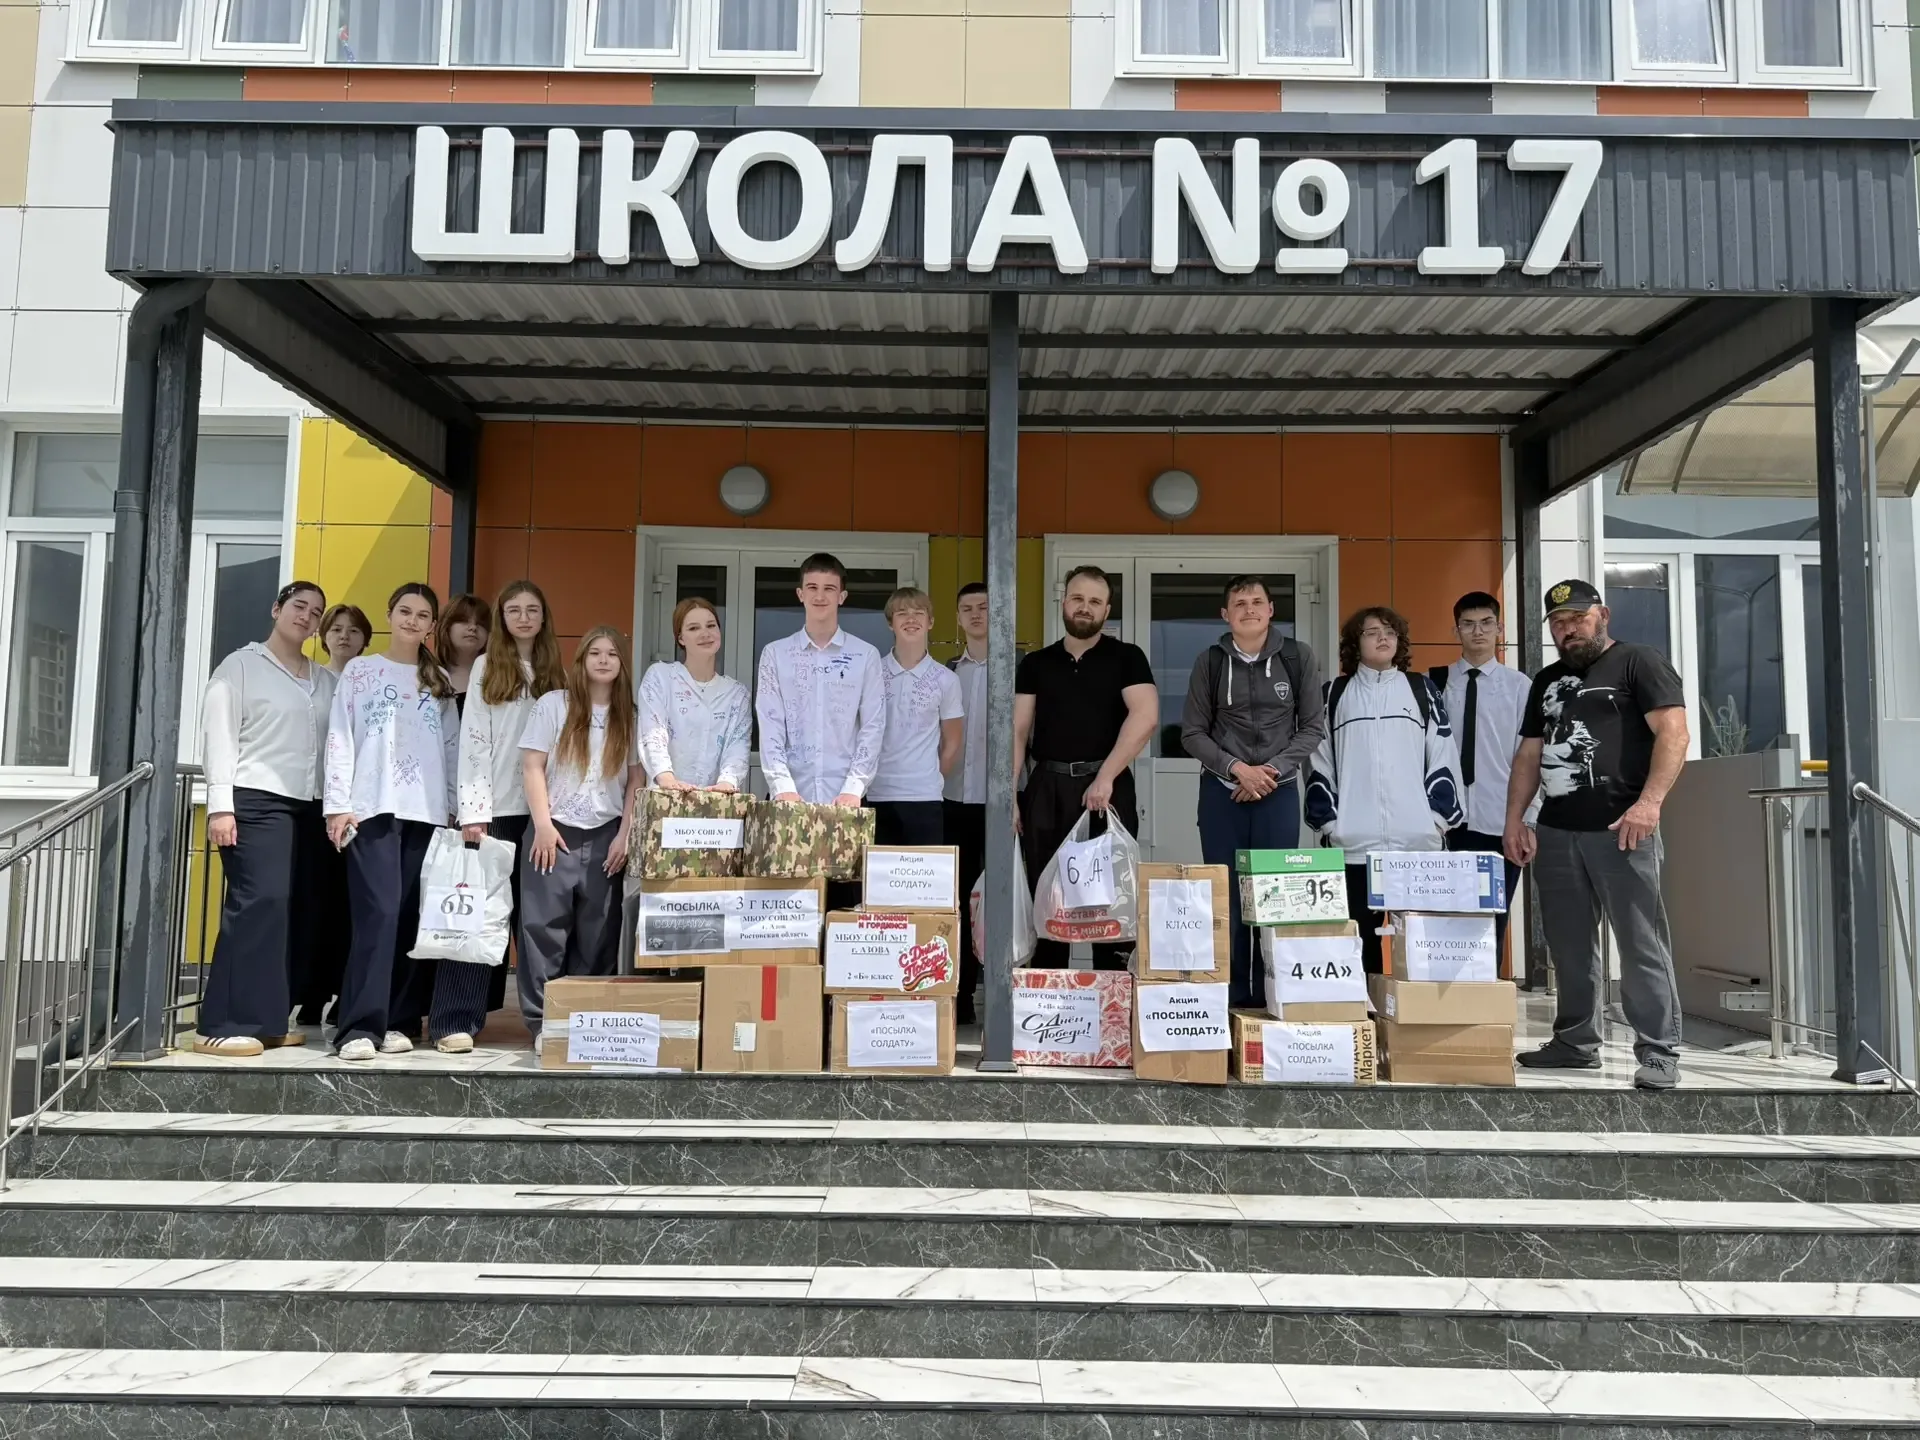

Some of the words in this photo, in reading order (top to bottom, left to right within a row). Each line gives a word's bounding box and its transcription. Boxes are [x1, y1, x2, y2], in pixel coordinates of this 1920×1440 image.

[411, 126, 1090, 275] ШКОЛА
[1151, 137, 1350, 275] №
[1416, 138, 1604, 277] 17
[674, 828, 697, 836] МБОУ
[697, 828, 716, 836] СОШ
[899, 855, 924, 863] Акция
[1389, 860, 1418, 869] МБОУ
[1420, 860, 1445, 869] СОШ
[1447, 860, 1458, 869] №
[1461, 860, 1470, 869] 17
[890, 867, 935, 876] «ПОСЫЛКА
[1067, 856, 1080, 885] 6
[889, 880, 932, 889] СОЛДАТУ»
[440, 893, 474, 916] 6Б
[660, 901, 720, 912] «ПОСЫЛКА
[736, 895, 744, 910] 3
[749, 900, 757, 910] г
[761, 899, 803, 910] класс
[1054, 908, 1108, 920] Доставка
[1177, 906, 1190, 916] 8Г
[742, 914, 768, 922] МБОУ
[768, 913, 789, 921] СОШ
[1165, 920, 1202, 930] КЛАСС
[1051, 925, 1064, 935] от
[1067, 926, 1078, 936] 15
[1080, 924, 1115, 936] минут
[740, 932, 780, 940] Ростовская
[781, 931, 809, 939] область
[834, 933, 864, 941] МБОУ
[864, 933, 887, 941] СОШ
[1415, 940, 1441, 949] МБОУ
[1444, 940, 1467, 949] СОШ
[1468, 941, 1487, 949] №17
[860, 946, 890, 954] АЗОВА
[1291, 962, 1304, 980] 4
[1310, 961, 1352, 979] «А»
[847, 972, 852, 980] 2
[1168, 996, 1199, 1005] Акция
[880, 1012, 905, 1021] Акция
[1145, 1010, 1209, 1021] «ПОСЫЛКА
[576, 1013, 584, 1028] 3
[589, 1017, 597, 1027] г
[602, 1016, 644, 1027] класс
[1021, 1013, 1044, 1031] С
[870, 1026, 917, 1035] «ПОСЫЛКА
[1166, 1026, 1226, 1036] СОЛДАТУ»
[1296, 1029, 1322, 1037] Акция
[582, 1035, 608, 1043] МБОУ
[608, 1035, 628, 1044] СОШ
[870, 1039, 915, 1048] СОЛДАТУ»
[1287, 1042, 1335, 1051] «ПОСЫЛКА
[1360, 1025, 1375, 1080] Маркет
[578, 1053, 618, 1062] Ростовская
[619, 1055, 647, 1063] область
[1287, 1055, 1332, 1065] СОЛДАТУ»
